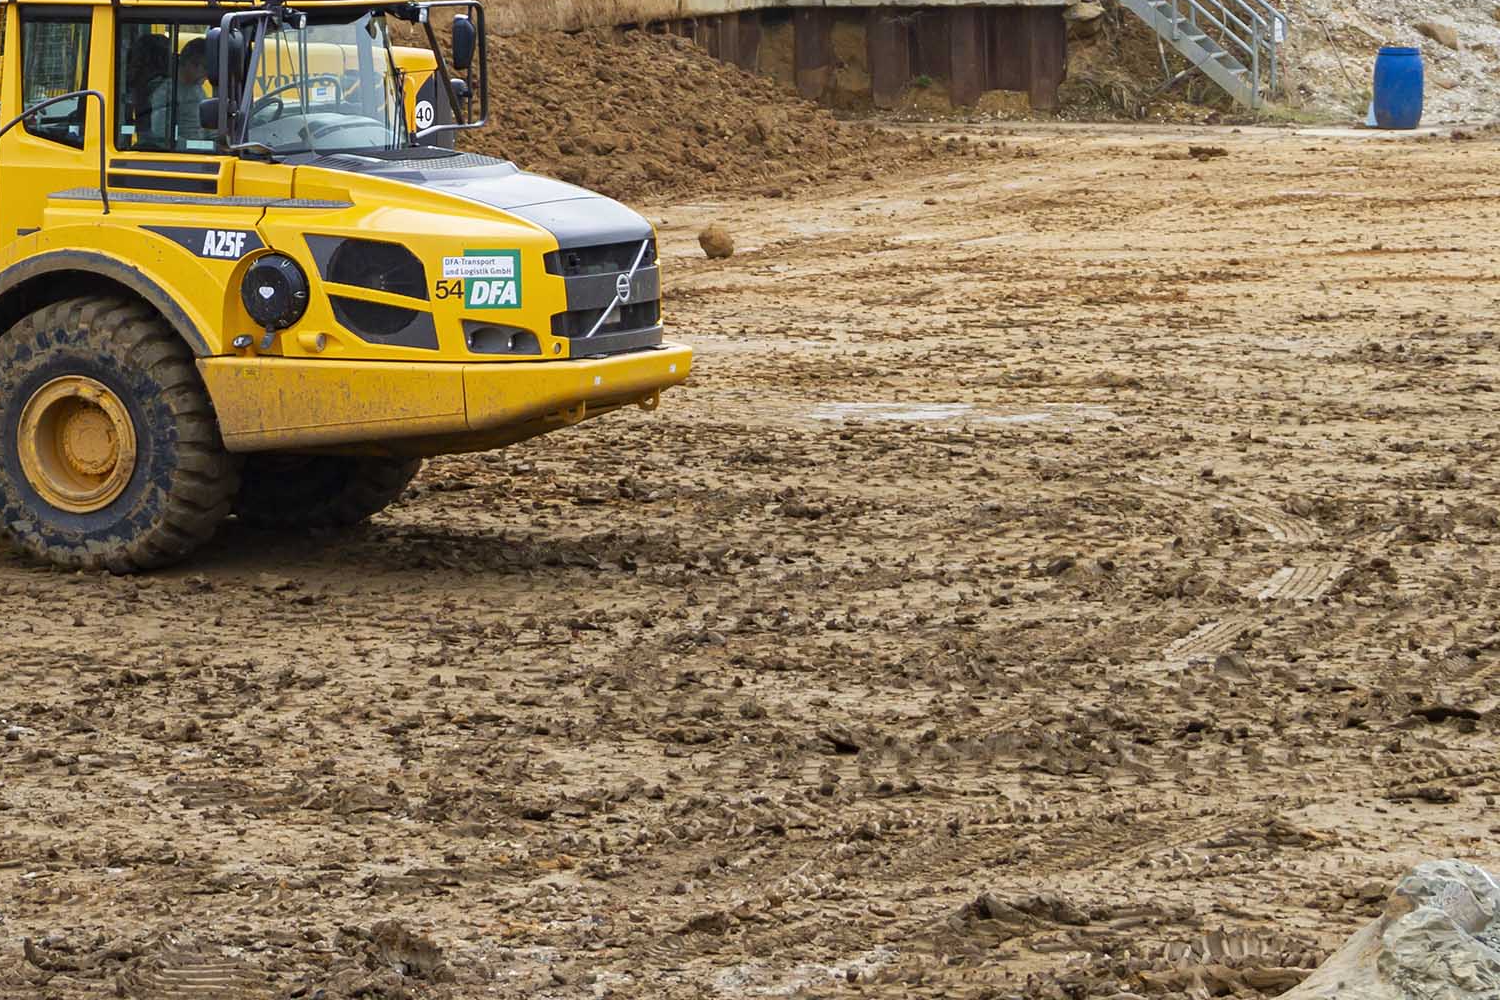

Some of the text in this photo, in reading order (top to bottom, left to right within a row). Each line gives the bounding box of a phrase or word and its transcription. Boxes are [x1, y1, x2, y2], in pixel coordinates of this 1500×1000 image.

[416, 106, 432, 122] 40
[202, 229, 247, 258] A25F
[445, 267, 511, 276] und Logistik GmbH
[435, 280, 465, 300] 54
[469, 280, 517, 305] DFA
